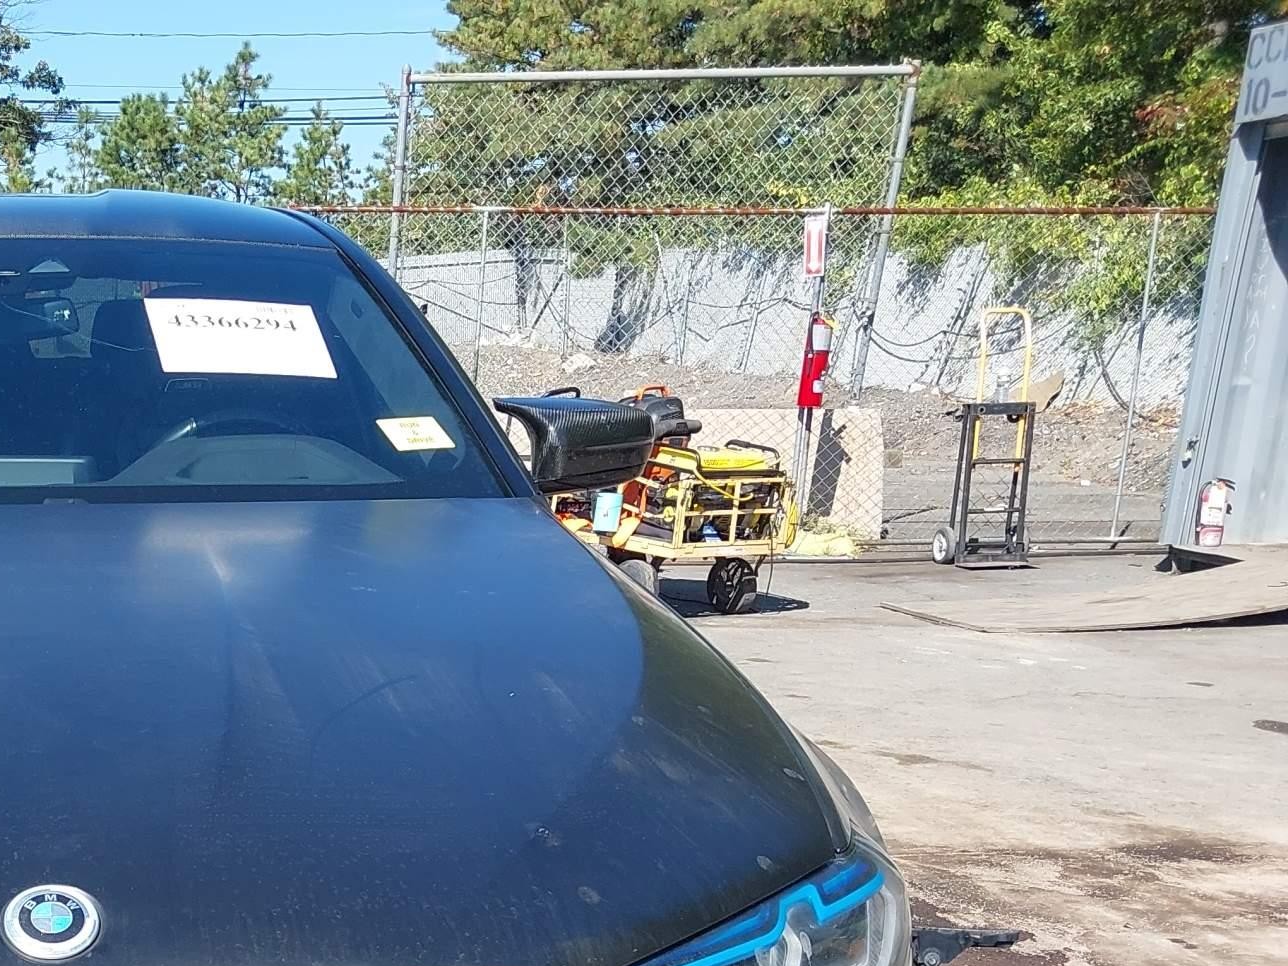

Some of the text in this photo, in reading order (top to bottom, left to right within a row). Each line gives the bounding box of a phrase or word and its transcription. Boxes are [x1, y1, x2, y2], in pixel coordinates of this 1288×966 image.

[1246, 25, 1288, 70] CC
[167, 313, 297, 332] 43366294
[24, 894, 80, 911] BMW
